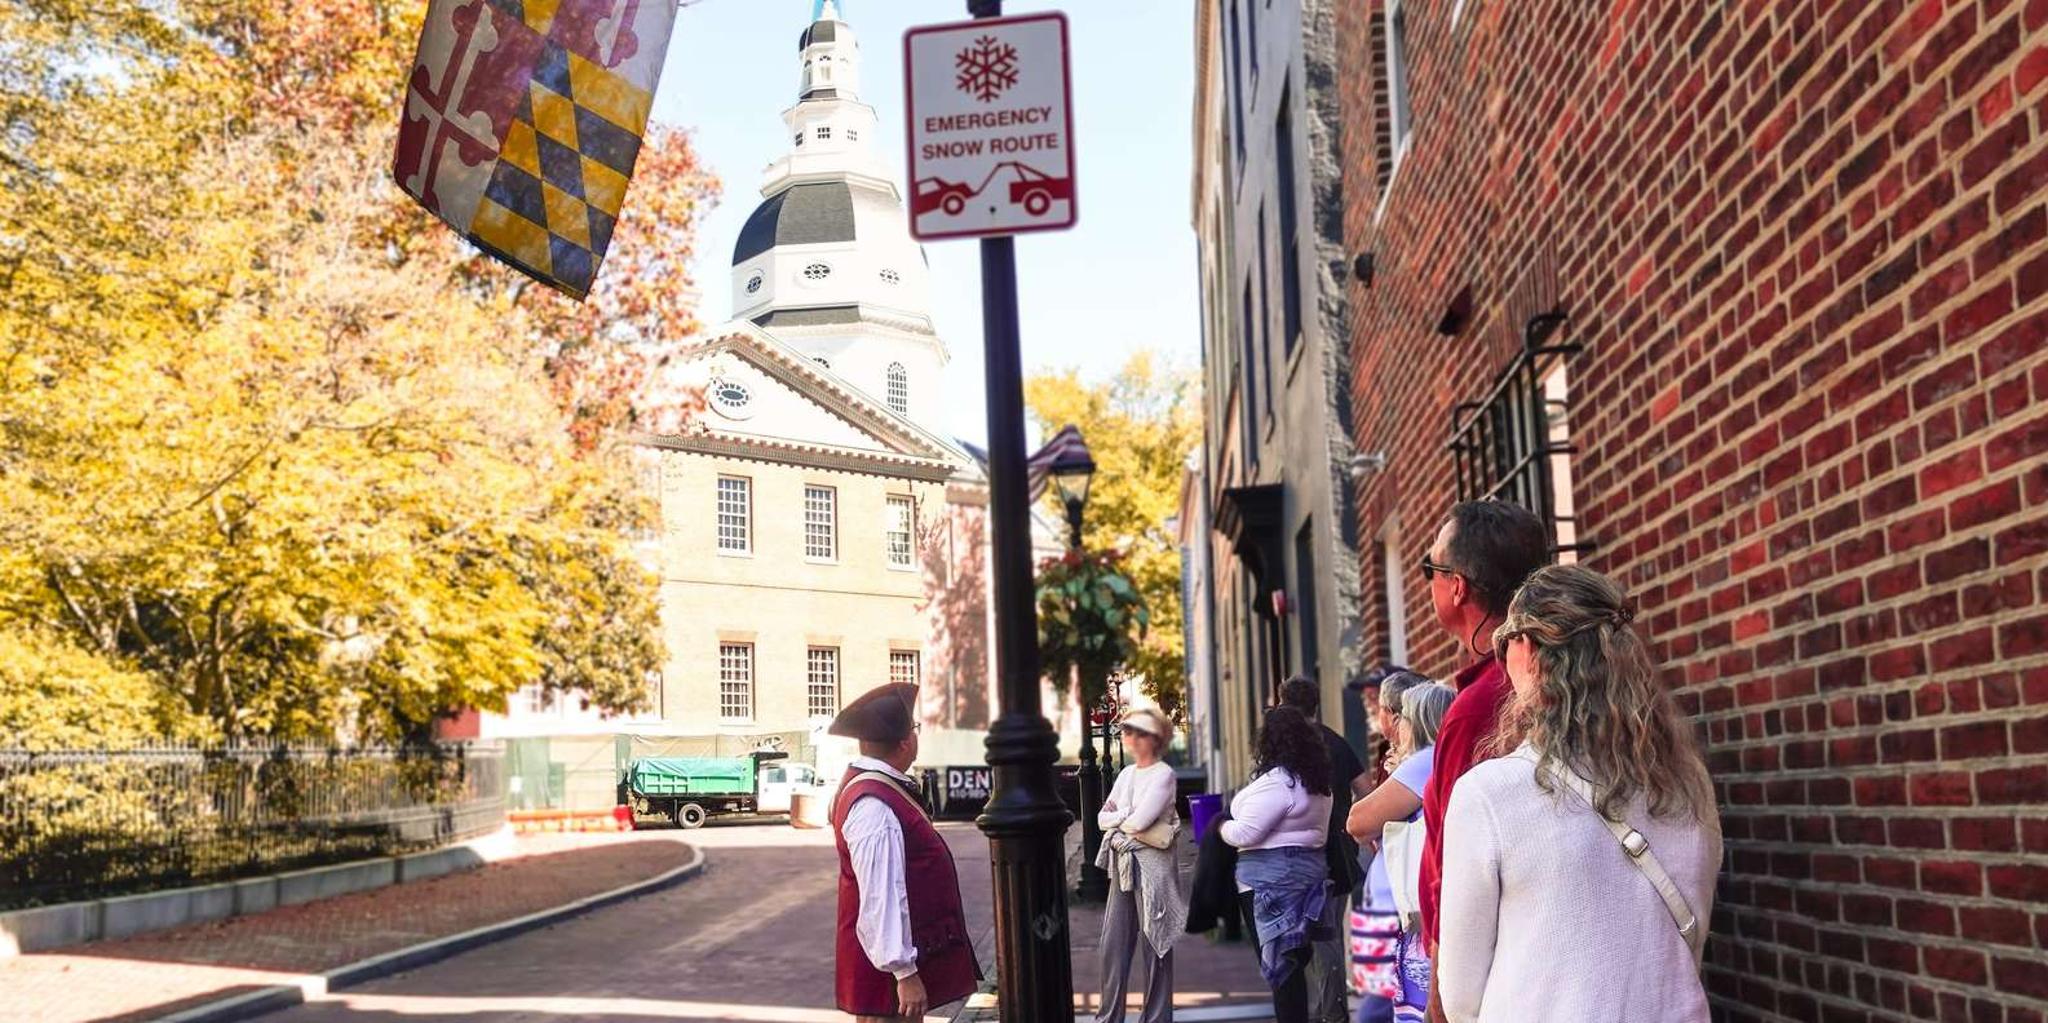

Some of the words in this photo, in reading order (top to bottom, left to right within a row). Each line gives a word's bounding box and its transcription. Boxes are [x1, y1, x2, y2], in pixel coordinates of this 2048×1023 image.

[925, 106, 1052, 133] EMERGENCY
[922, 140, 984, 160] SNOW
[989, 132, 1058, 154] ROUTE
